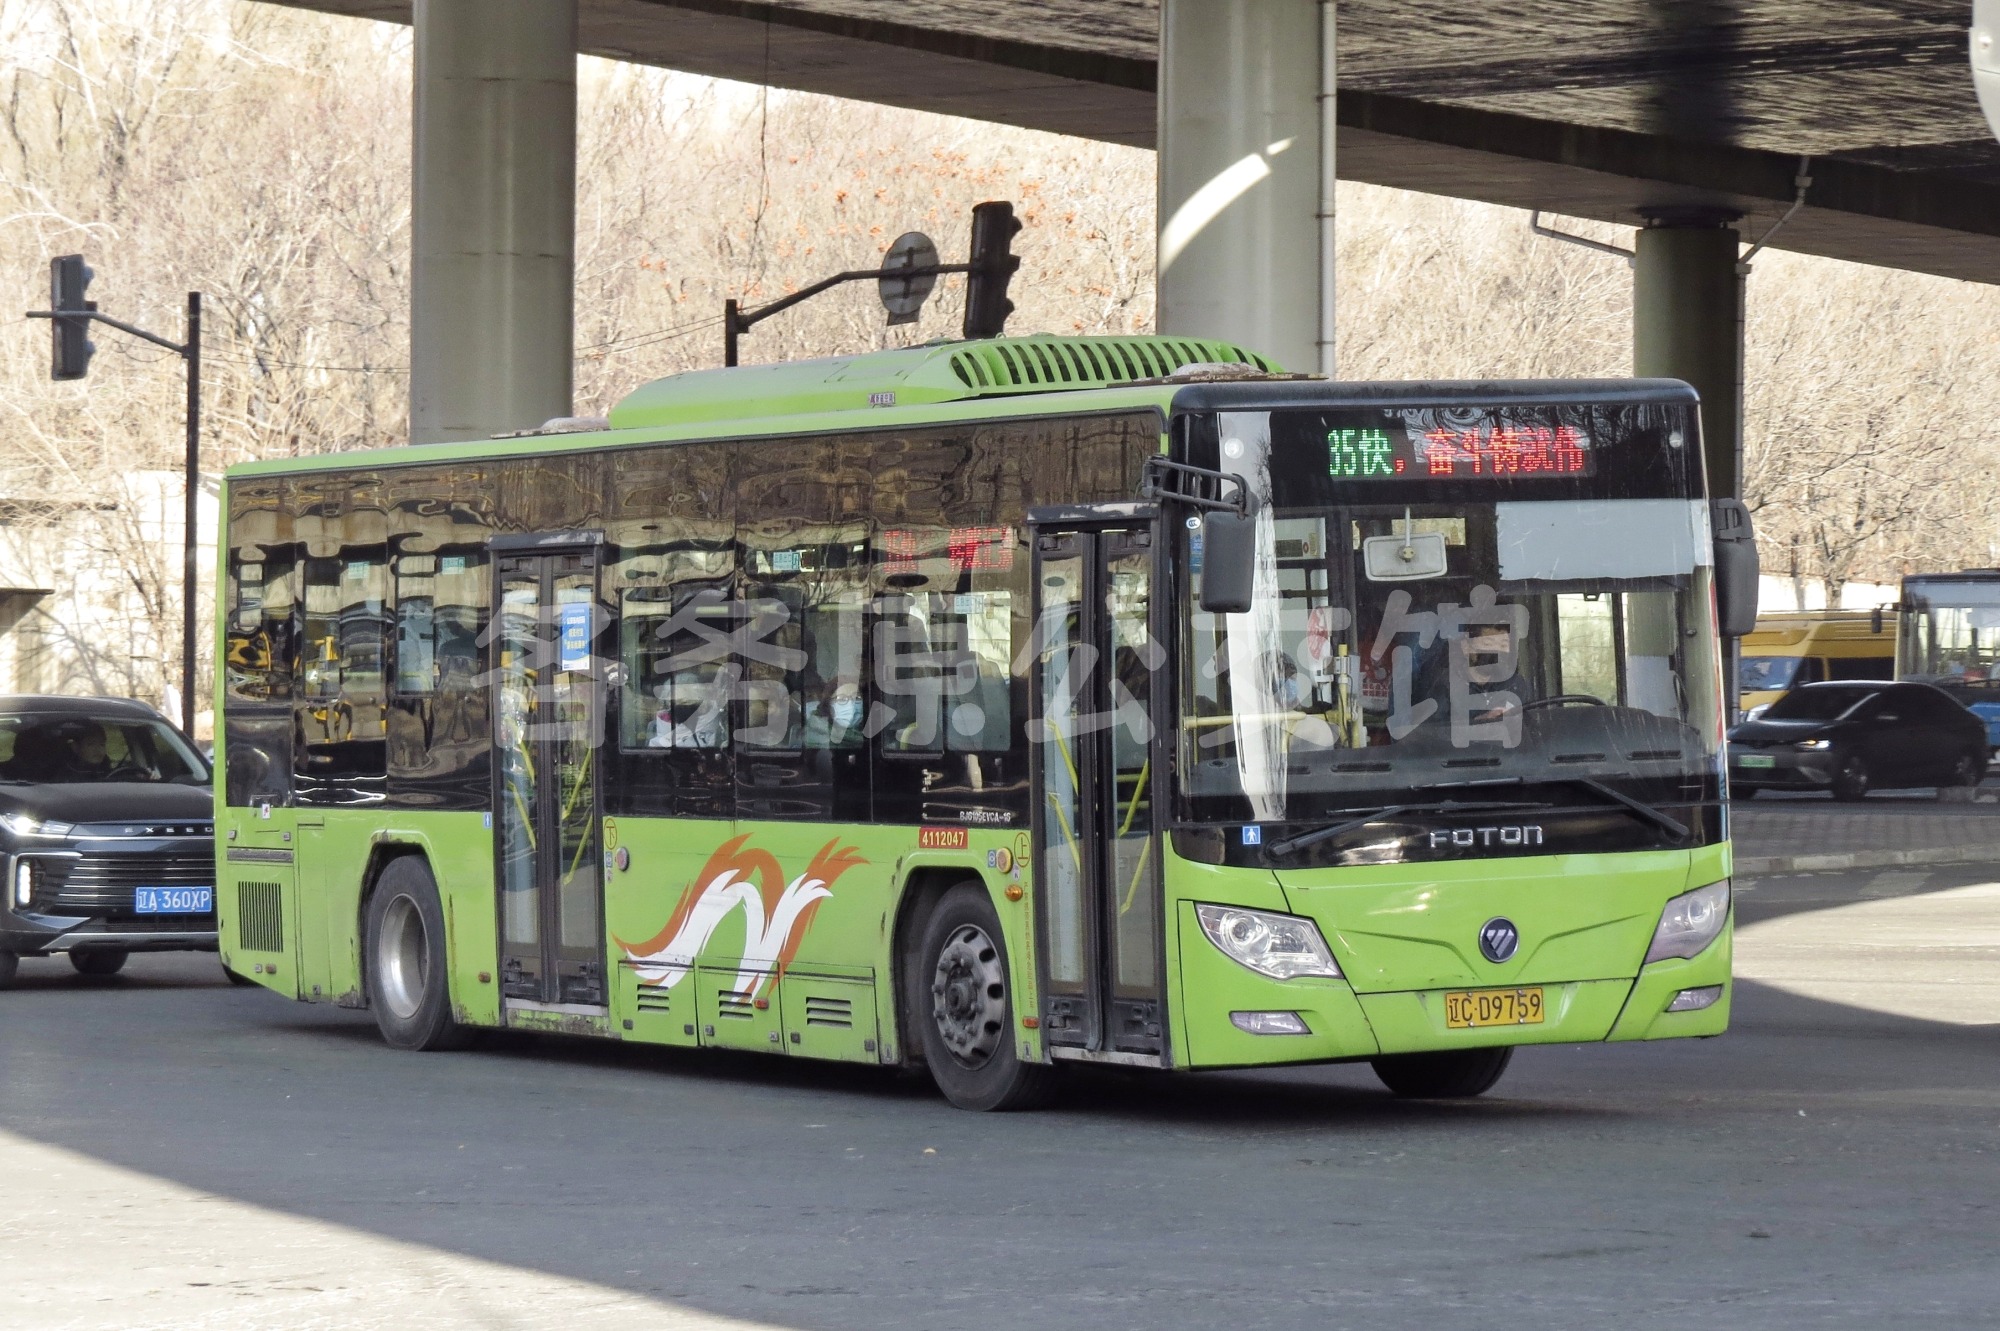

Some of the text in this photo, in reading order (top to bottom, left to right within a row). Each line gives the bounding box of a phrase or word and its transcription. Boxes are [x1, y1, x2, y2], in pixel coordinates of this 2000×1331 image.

[124, 826, 214, 834] EXEED
[1430, 825, 1543, 848] FOTON
[922, 831, 965, 846] 4112047
